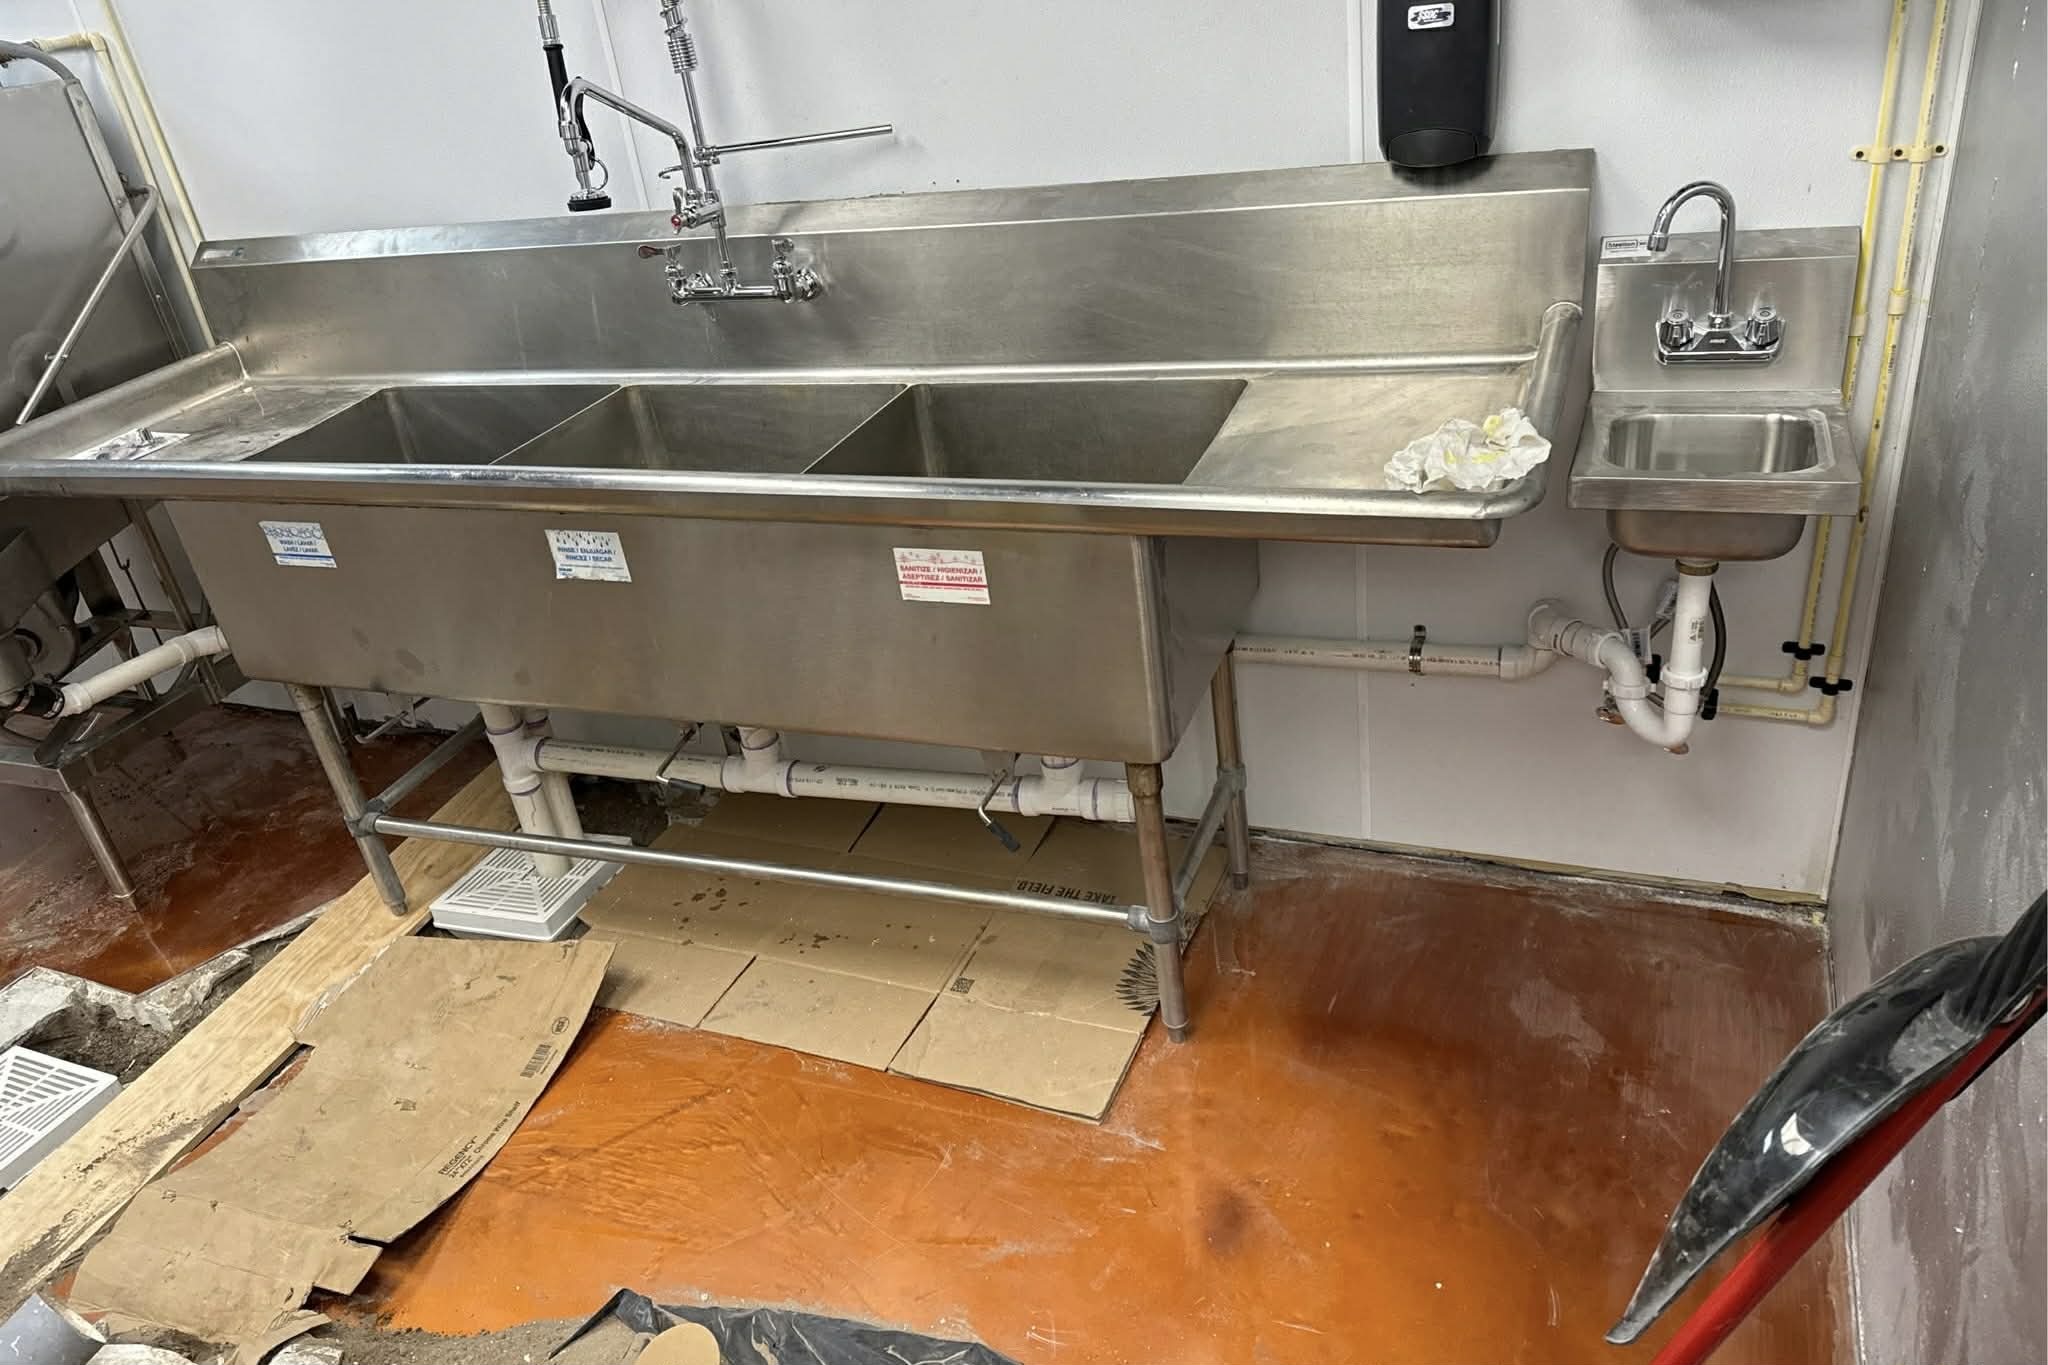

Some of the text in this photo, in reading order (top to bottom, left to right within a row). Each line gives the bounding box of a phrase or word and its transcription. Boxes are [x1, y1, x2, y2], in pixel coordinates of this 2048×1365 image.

[937, 567, 977, 575] HIGIENIZAR
[945, 574, 983, 584] SANITIZAR
[1056, 887, 1081, 899] THE
[1083, 891, 1116, 904] TAKE
